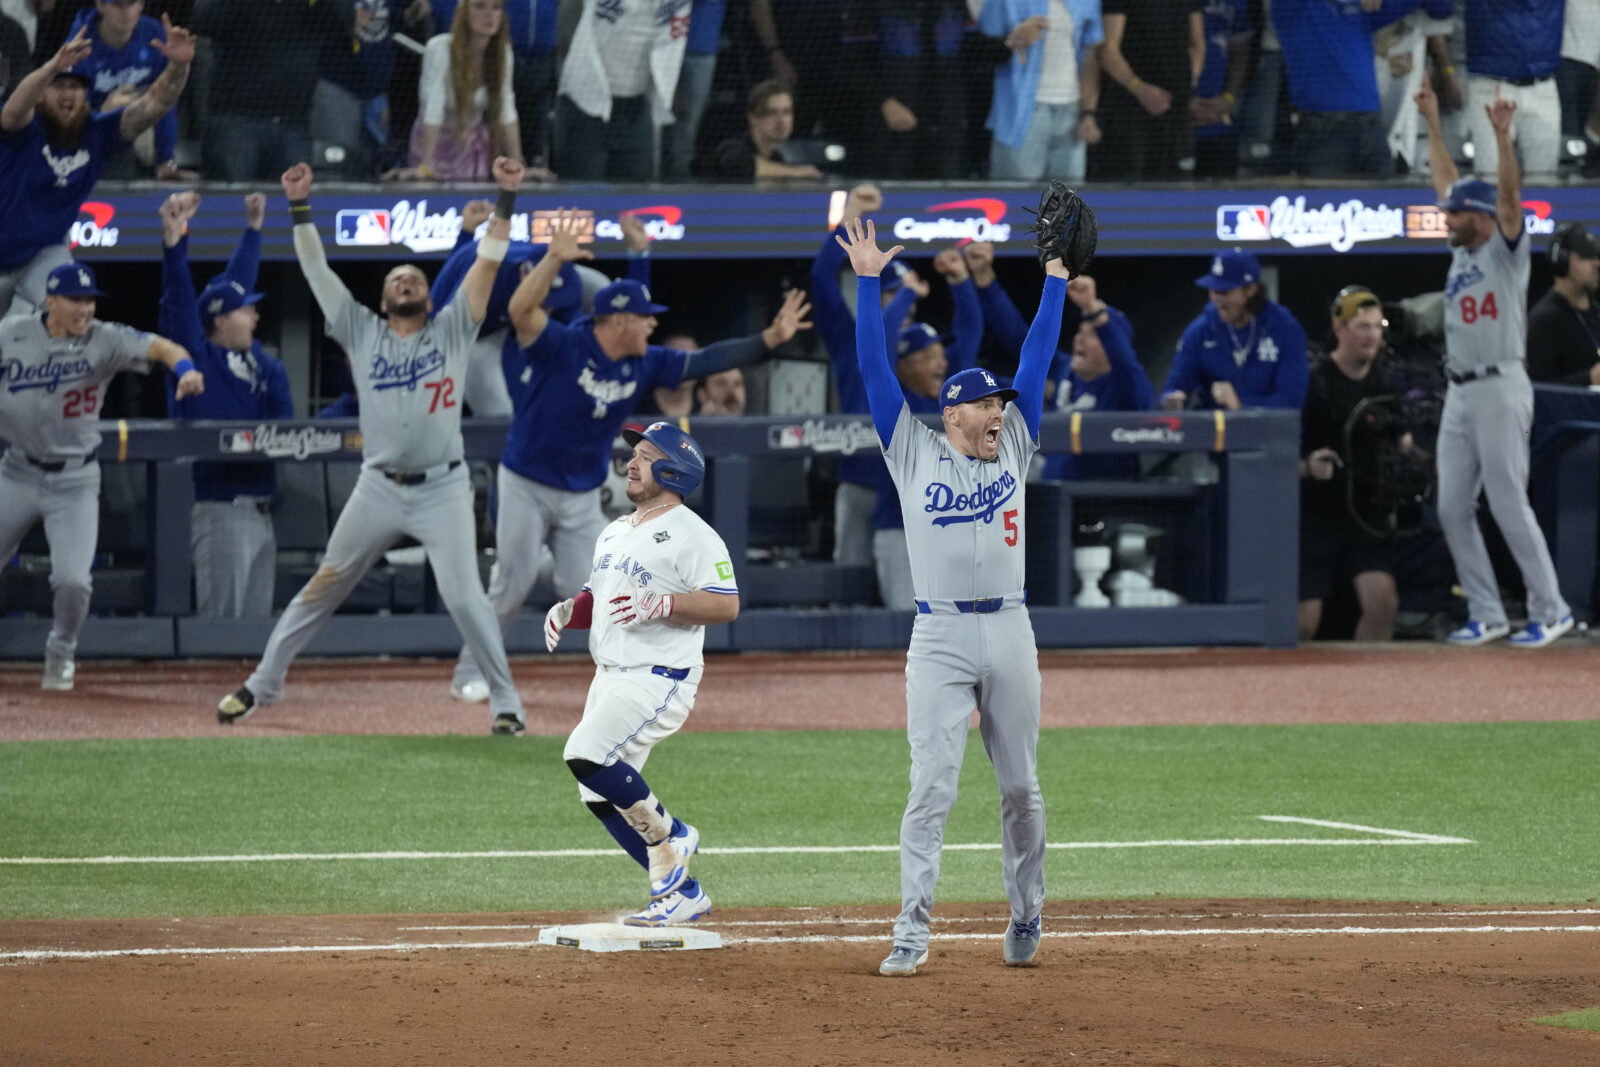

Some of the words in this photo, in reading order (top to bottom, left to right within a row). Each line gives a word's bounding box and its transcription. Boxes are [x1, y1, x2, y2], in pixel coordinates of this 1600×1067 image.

[1460, 292, 1498, 324] 84
[5, 358, 95, 393] Dodgers
[370, 348, 445, 391] Dodgers
[980, 371, 996, 387] LA
[64, 385, 99, 418] 25
[424, 377, 456, 414] 72
[925, 470, 1017, 528] Dodgers
[1003, 509, 1019, 547] 5
[614, 553, 652, 586] JAYS
